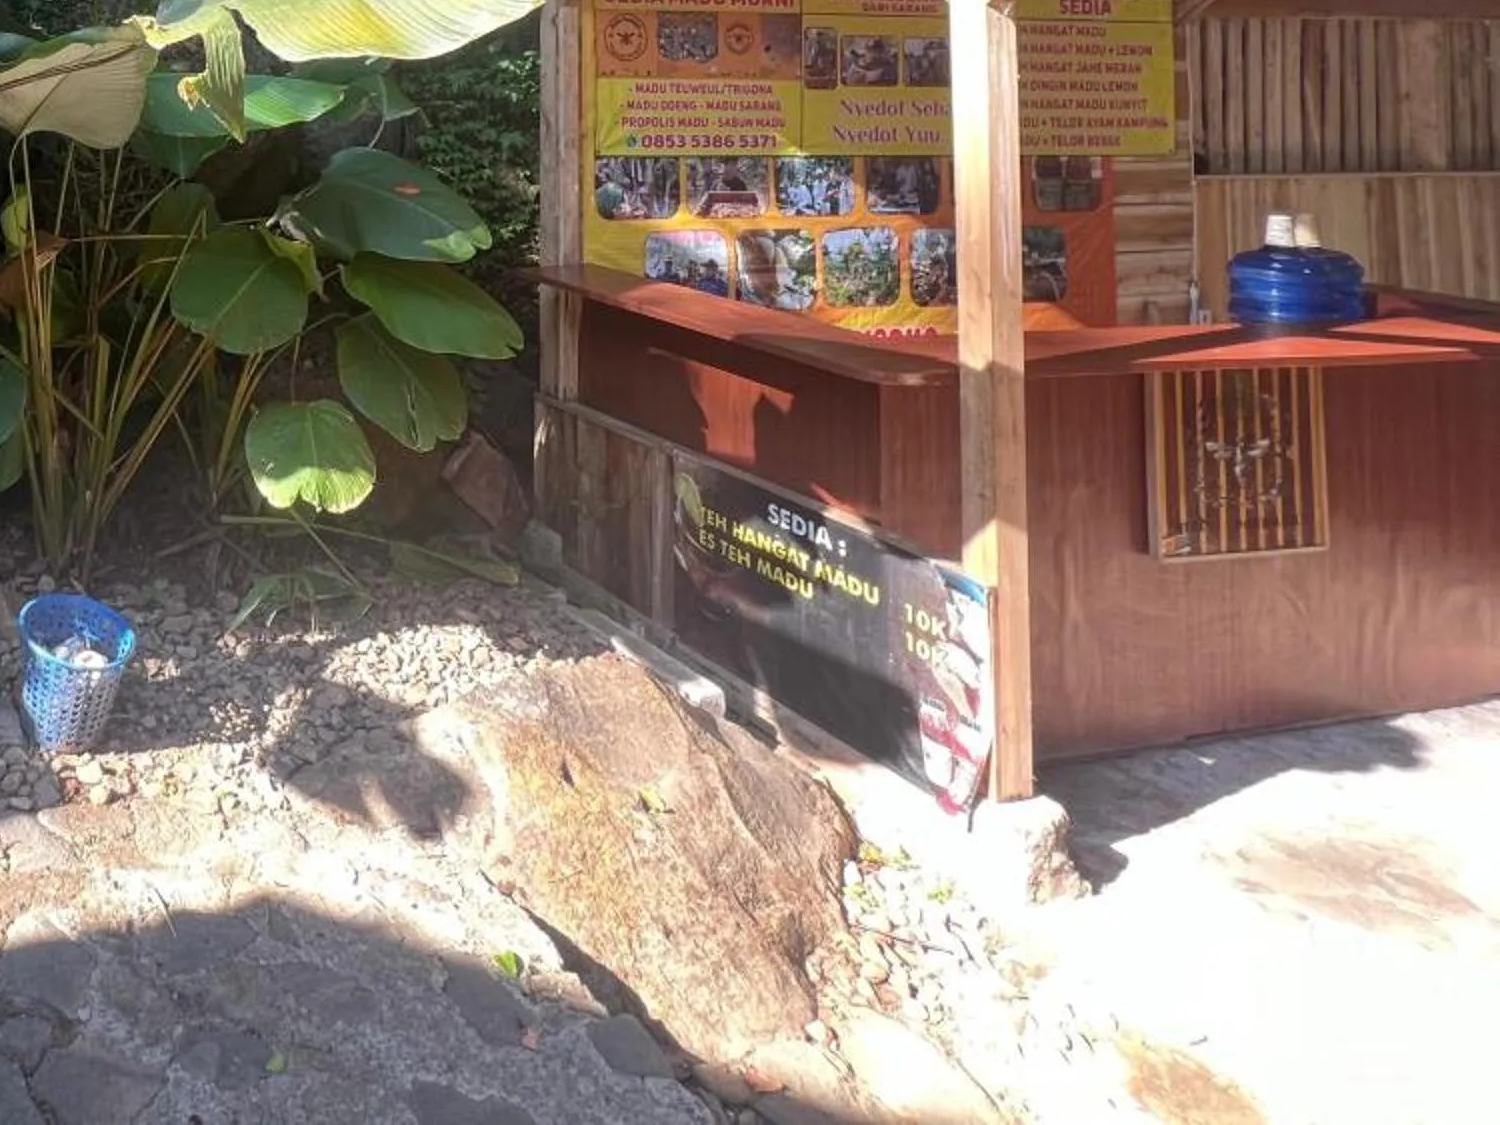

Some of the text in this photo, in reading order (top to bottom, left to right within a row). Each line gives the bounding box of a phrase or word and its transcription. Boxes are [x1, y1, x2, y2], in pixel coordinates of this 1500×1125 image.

[1030, 26, 1074, 36] HANGAT
[1078, 26, 1106, 37] MADU
[1030, 44, 1073, 55] HANGAT
[1076, 45, 1106, 56] MADU
[1116, 46, 1152, 56] LEMON
[1030, 62, 1073, 73] HANGAT
[635, 82, 666, 94] MADU
[1030, 80, 1066, 91] DINGIN
[1069, 81, 1099, 92] MADU
[1102, 81, 1139, 92] LEMON
[627, 100, 659, 111] MADU
[706, 101, 737, 112] MADU
[739, 101, 782, 112] SARANG
[841, 100, 903, 117] Nyedot
[1031, 99, 1073, 110] HANGAT
[1076, 99, 1106, 110] MADU
[621, 117, 786, 129] PROPOLIS MADU SABUN MADU
[833, 125, 898, 142] Nyedot
[641, 134, 777, 148] 0853 5386 5371
[767, 503, 833, 551] SEDIA
[700, 506, 879, 606] TEH HANGAT MADU
[700, 528, 813, 599] ES TEH MADU
[904, 603, 947, 642] 10K
